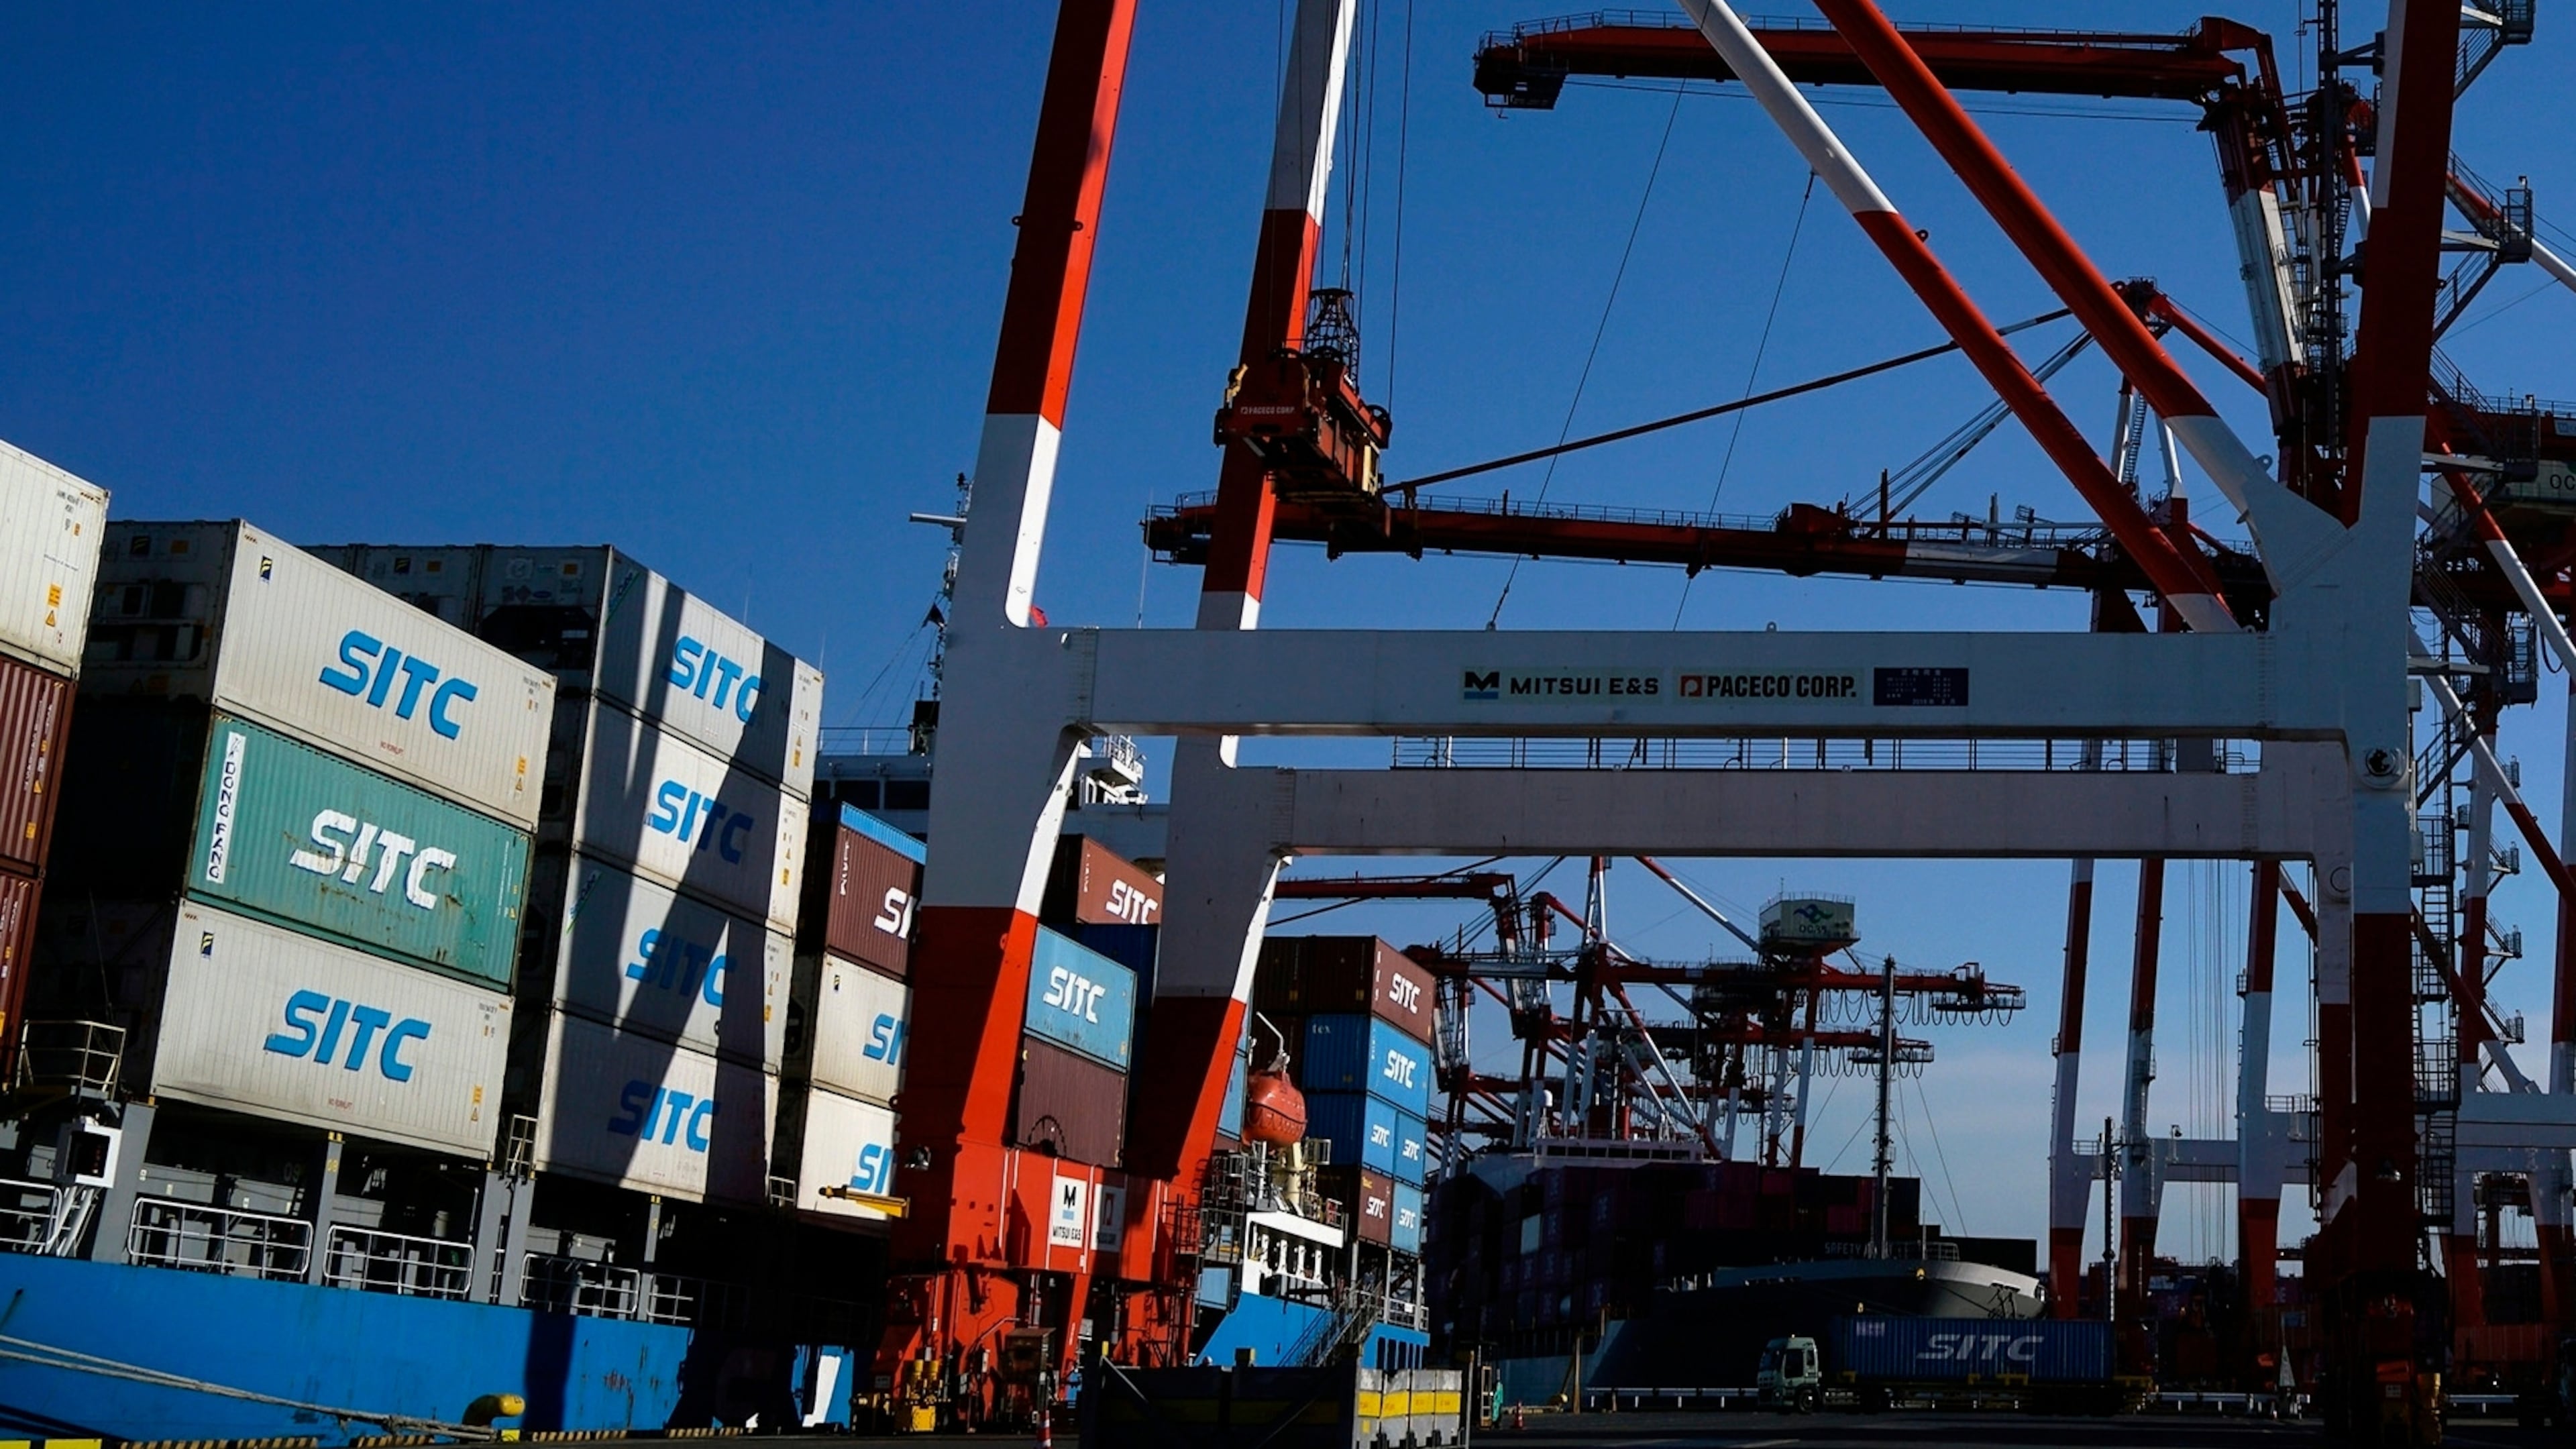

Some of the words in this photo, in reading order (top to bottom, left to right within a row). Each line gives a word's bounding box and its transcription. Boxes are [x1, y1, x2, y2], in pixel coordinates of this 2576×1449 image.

[319, 629, 478, 741] SITC
[663, 635, 769, 725] SITC
[1510, 678, 1600, 695] MITSUI
[1609, 678, 1659, 695] E&S
[1707, 675, 1790, 698] PACECO
[1796, 675, 1857, 698] CORP.
[645, 780, 754, 865] SITC
[209, 822, 227, 879] FANG
[289, 808, 458, 910] SITC
[1105, 878, 1159, 924] SITC
[626, 928, 737, 1008] SITC
[1042, 965, 1106, 1024] SITC
[1389, 972, 1421, 1014] SITC
[264, 989, 431, 1083] SITC
[1384, 1049, 1416, 1089] SITC
[608, 1081, 721, 1153] SITC
[1371, 1124, 1390, 1148] SITC
[1403, 1138, 1421, 1161] SITC
[1365, 1195, 1387, 1220] SITC
[1398, 1208, 1417, 1230] SITC
[1825, 1241, 1862, 1256] SAFETY
[1916, 1333, 2045, 1362] SITC
